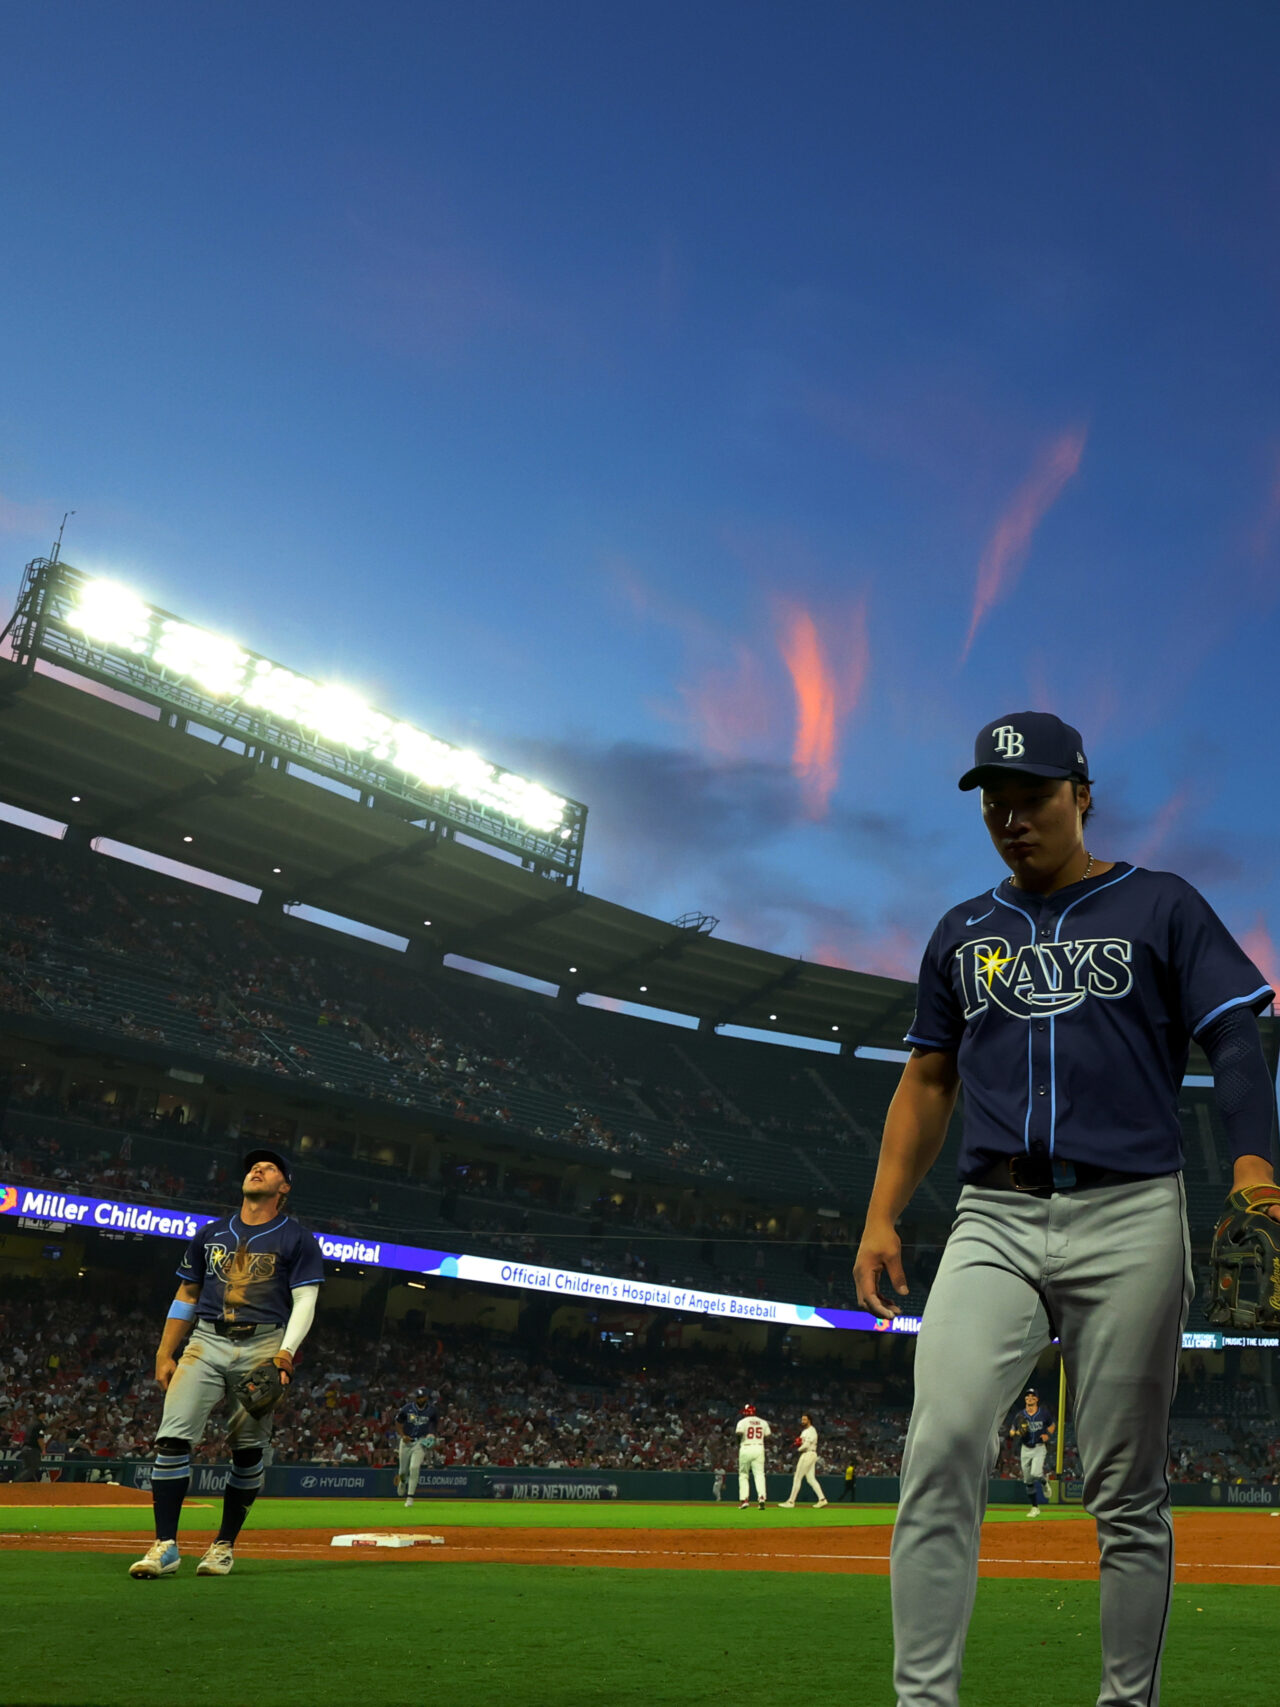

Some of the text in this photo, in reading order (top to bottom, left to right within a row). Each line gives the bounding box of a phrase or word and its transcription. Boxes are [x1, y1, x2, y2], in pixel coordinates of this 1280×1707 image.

[992, 725, 1026, 759] TB
[955, 936, 1133, 1020] RAYS
[21, 1192, 89, 1221] Miller
[94, 1203, 198, 1237] Children's
[501, 1266, 776, 1319] Official Children's Hospital of Angels Baseball
[747, 1427, 763, 1439] 85
[320, 1477, 364, 1488] HYUNDAI
[419, 1476, 468, 1486] ELS.OCNAV.ORG
[512, 1484, 601, 1499] MLB NETWORK
[1227, 1486, 1272, 1504] Modelo
